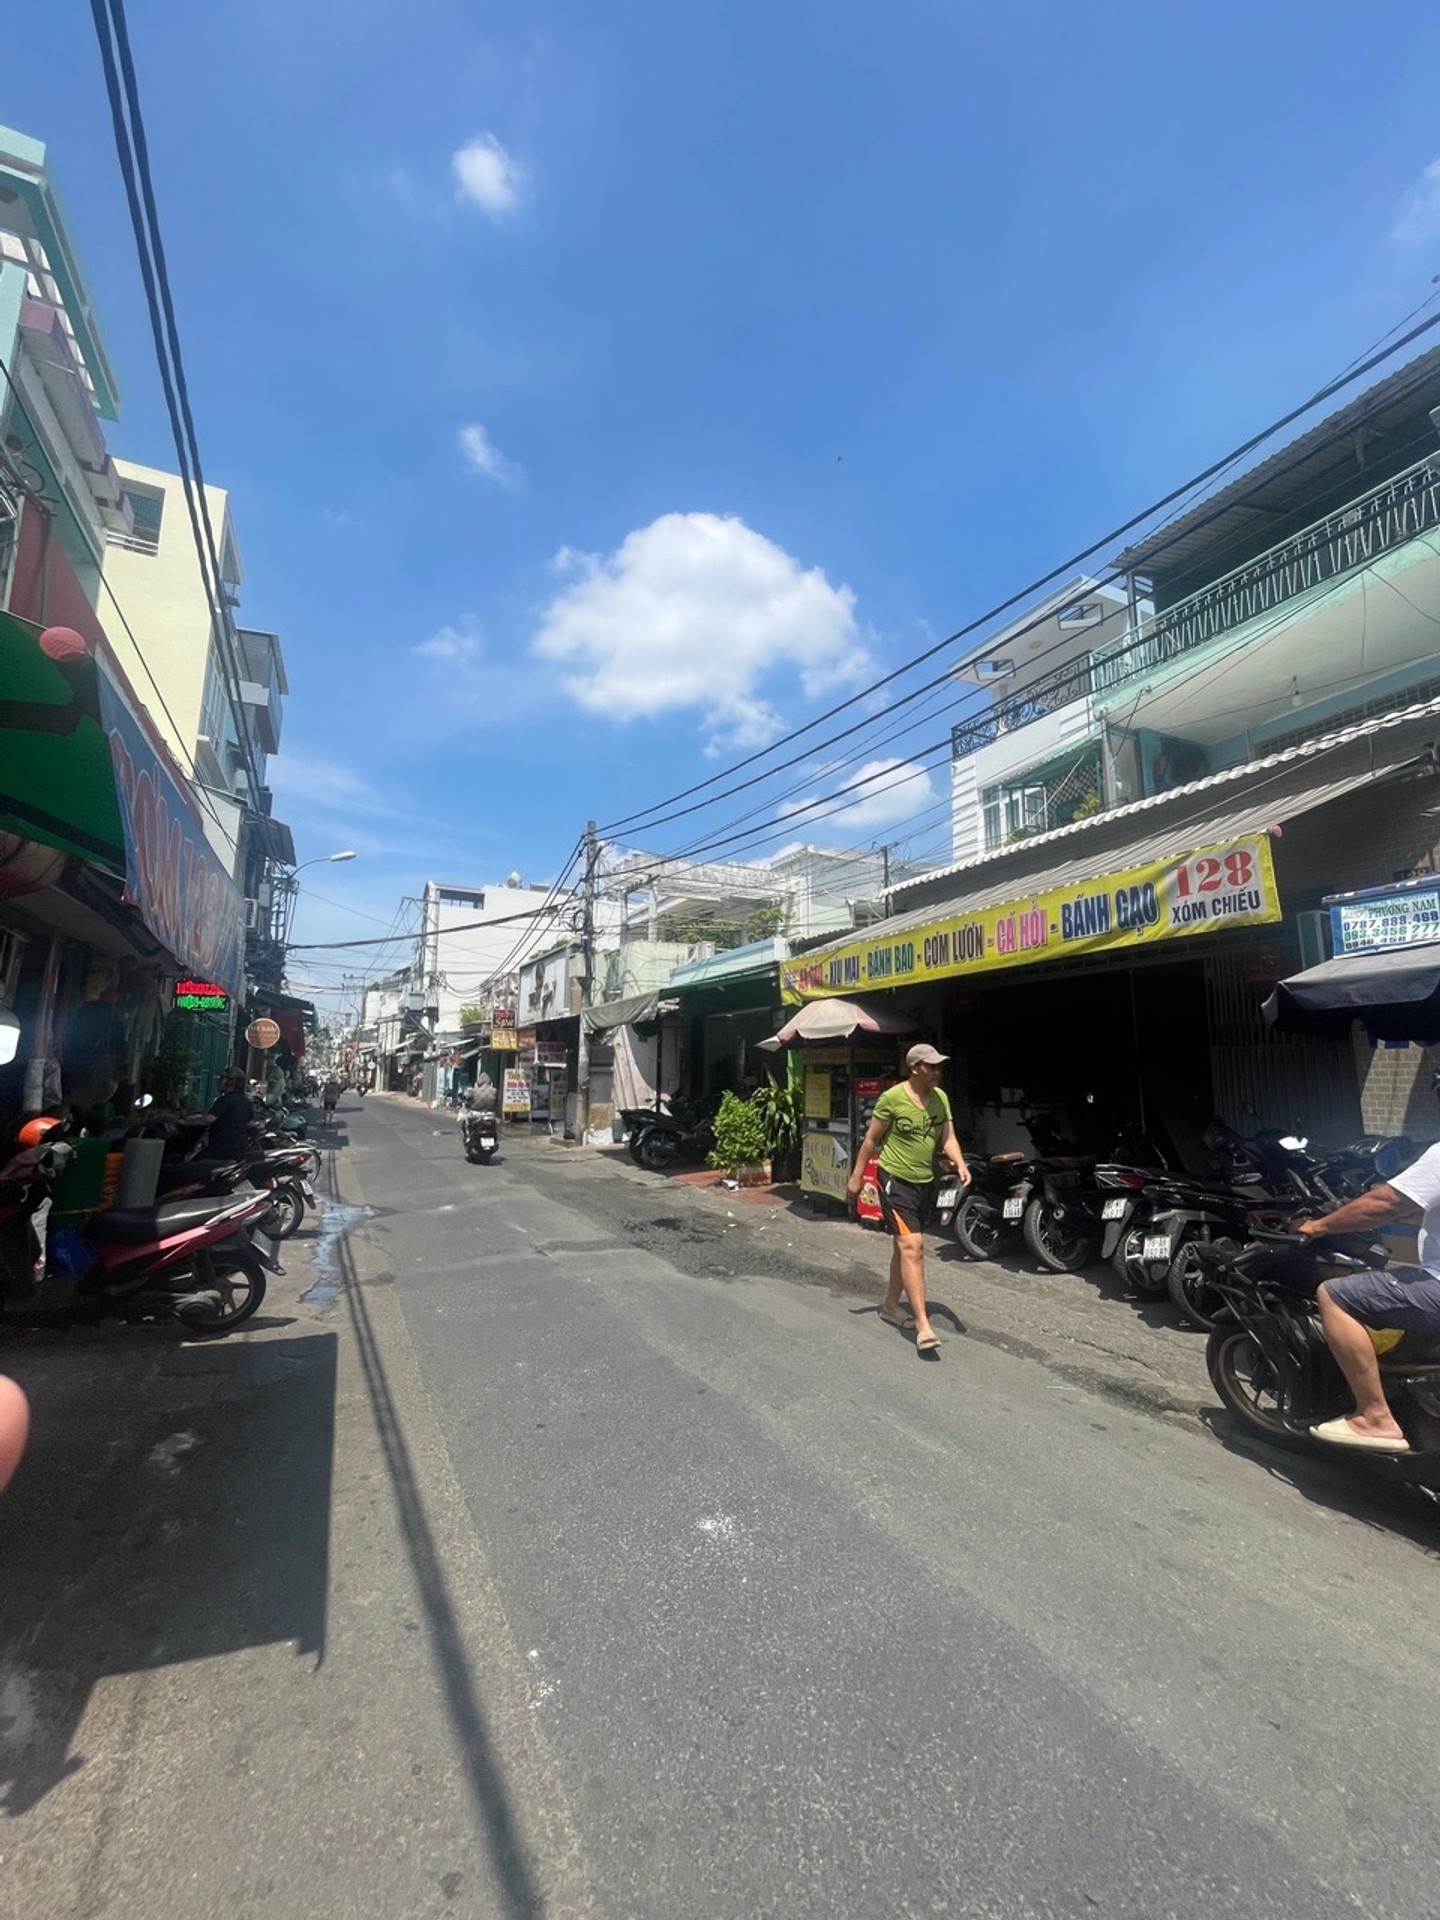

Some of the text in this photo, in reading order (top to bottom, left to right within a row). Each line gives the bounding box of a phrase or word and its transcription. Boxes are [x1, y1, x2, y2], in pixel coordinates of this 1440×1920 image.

[1175, 850, 1252, 898] 128
[1172, 887, 1261, 924] XÓM CHIẾU
[1412, 898, 1437, 912] NAM
[894, 941, 914, 973] BAO
[1061, 892, 1110, 940] BÁNH
[1115, 881, 1160, 935] GẠO
